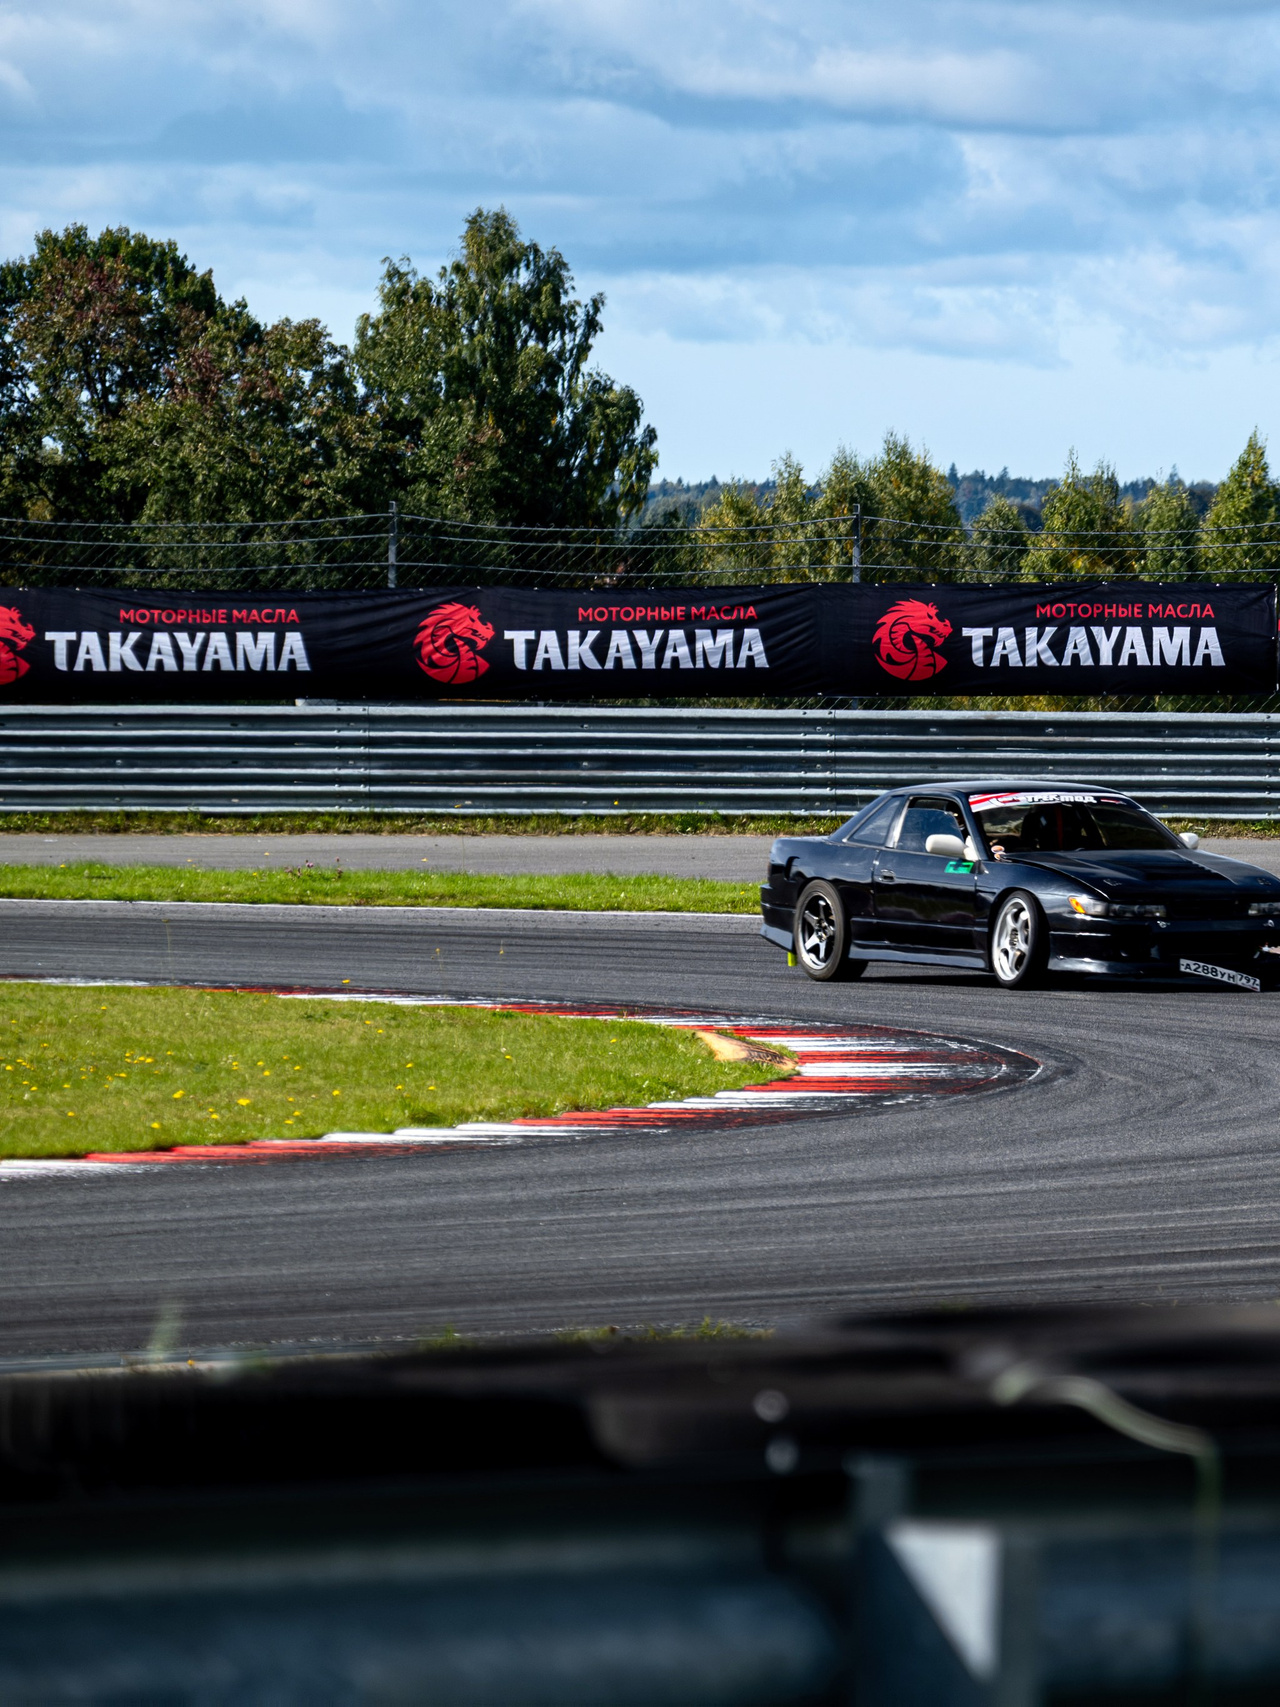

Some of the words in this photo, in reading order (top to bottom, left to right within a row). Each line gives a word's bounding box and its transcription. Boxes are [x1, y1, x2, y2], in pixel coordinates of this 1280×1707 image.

[119, 609, 228, 624] МОТОРНЫЕ
[231, 608, 300, 624] МАСЛА
[578, 606, 686, 622] МОТОРНЫЕ
[691, 605, 758, 621] МАСЛА
[1036, 603, 1143, 618] МОТОРНЫЕ
[1148, 603, 1215, 618] МАСЛА
[45, 631, 311, 672] TAKAYAMA
[504, 628, 770, 671] TAKAYAMA
[962, 626, 1226, 667] TAKAYAMA
